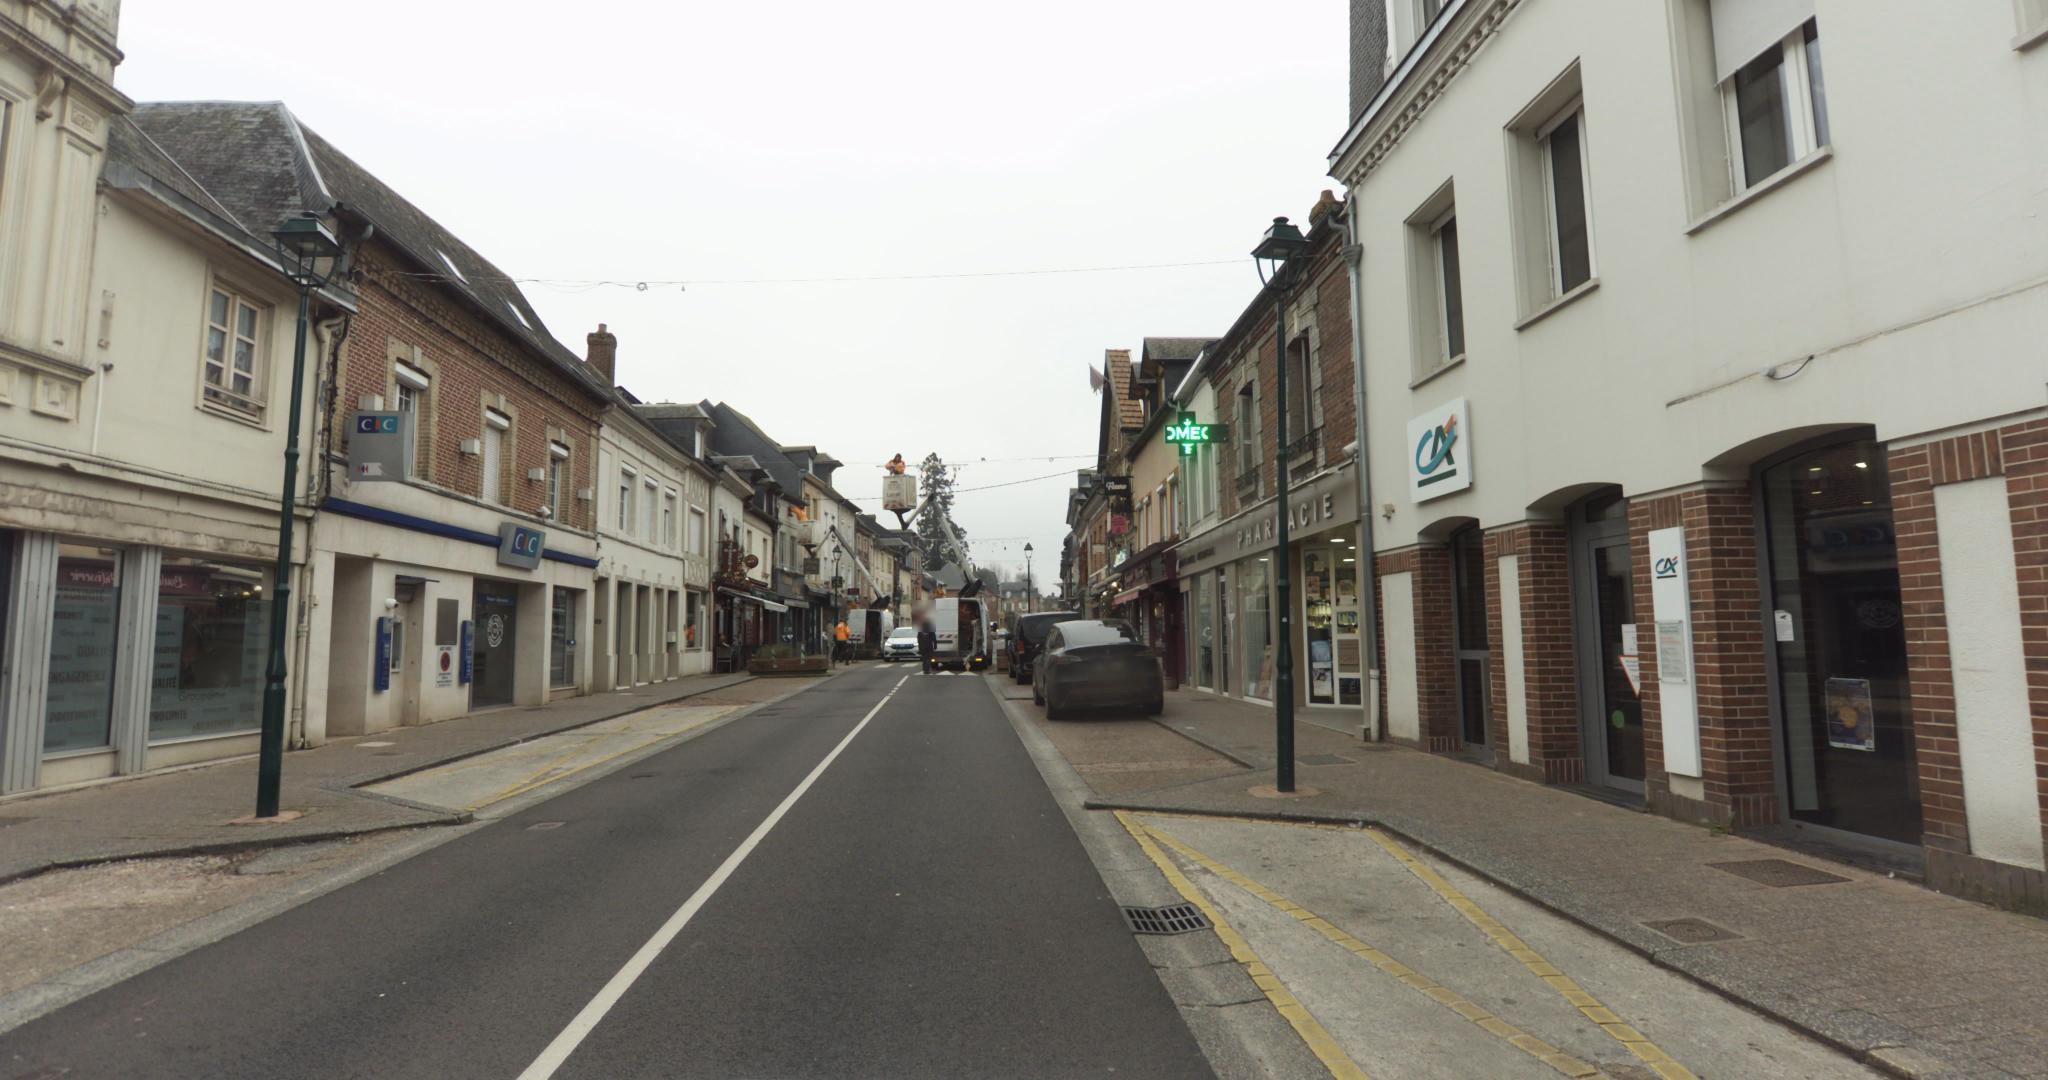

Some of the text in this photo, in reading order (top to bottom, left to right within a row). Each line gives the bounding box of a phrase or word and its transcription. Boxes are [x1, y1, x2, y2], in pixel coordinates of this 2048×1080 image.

[361, 418, 393, 431] CIC
[1237, 493, 1332, 550] PHARACIE
[515, 532, 537, 553] CIC
